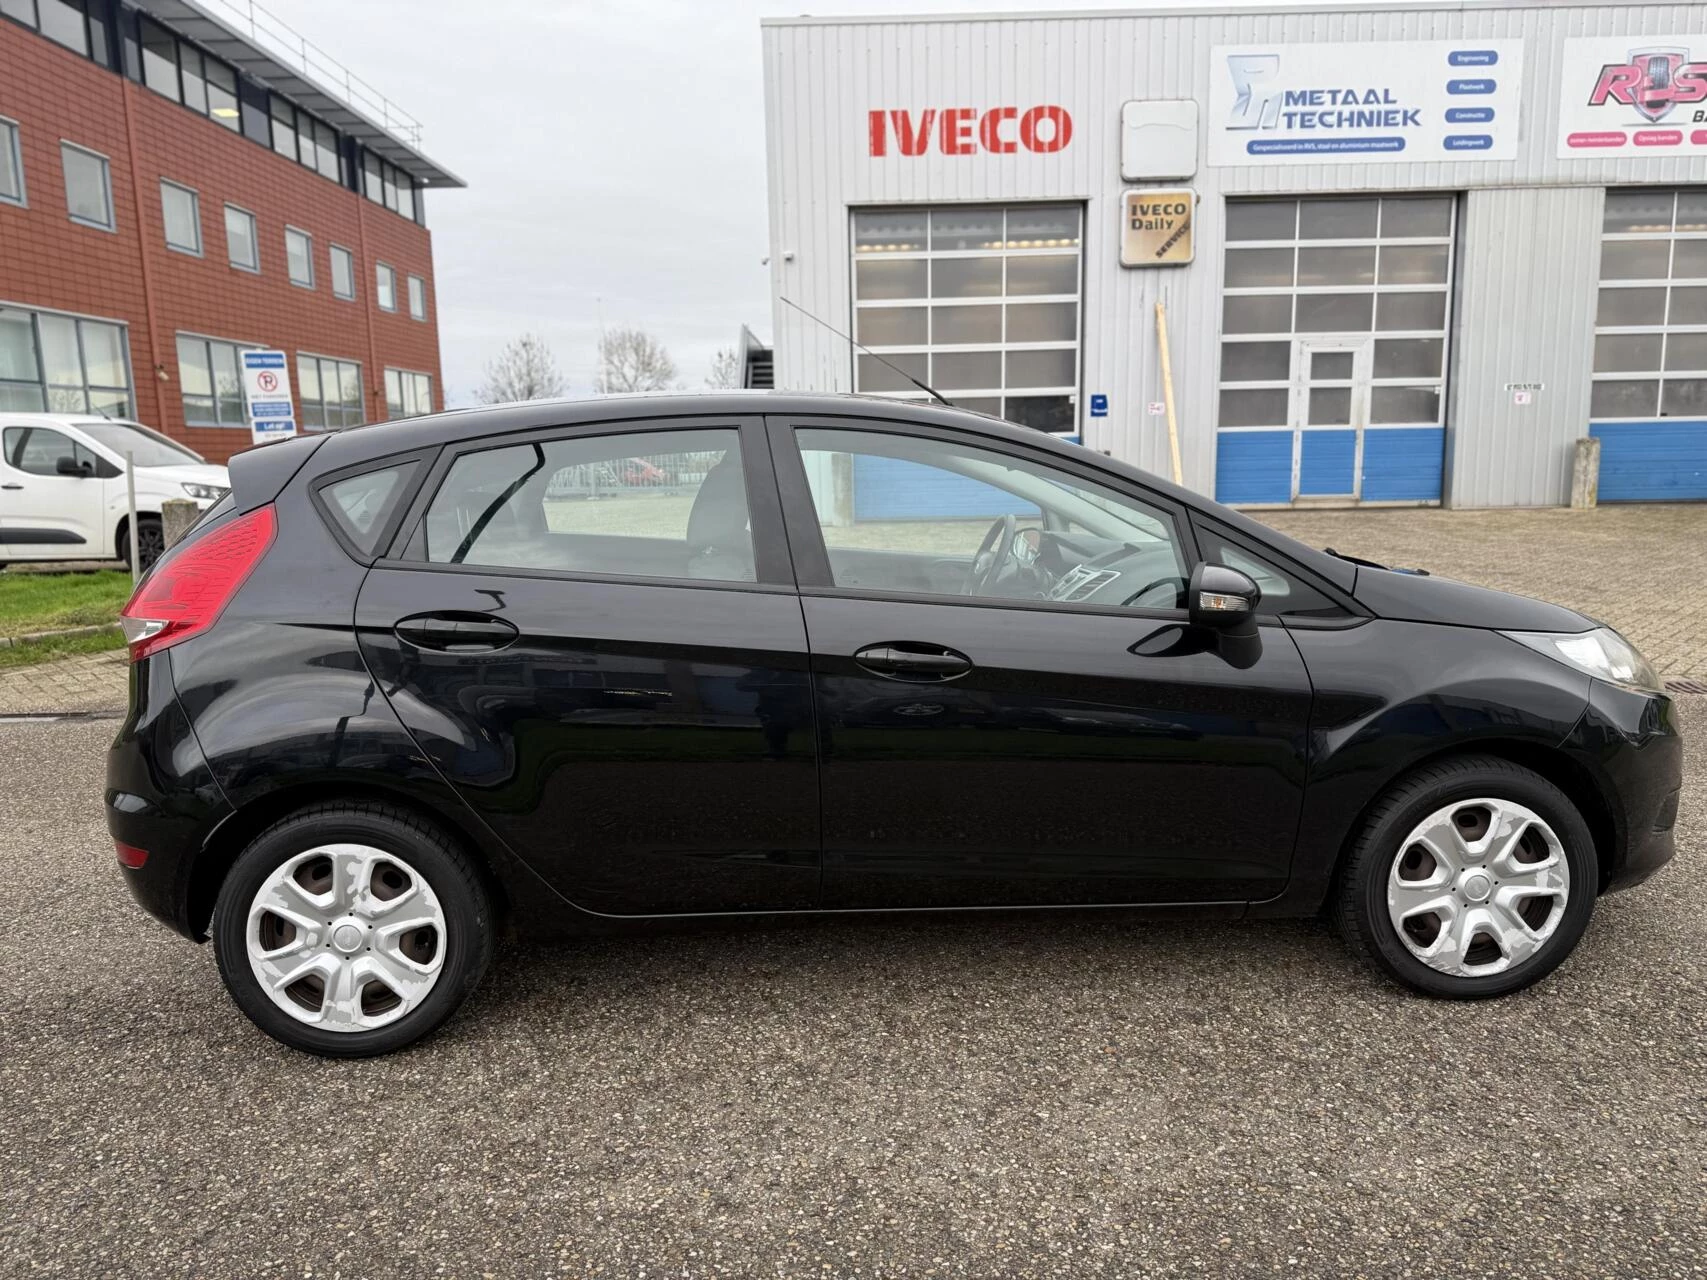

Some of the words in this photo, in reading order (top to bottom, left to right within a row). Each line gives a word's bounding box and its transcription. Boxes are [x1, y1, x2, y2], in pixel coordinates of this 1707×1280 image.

[1587, 62, 1707, 106] RS
[1285, 88, 1397, 107] METAAL
[1282, 108, 1422, 129] TECHNIEK
[868, 105, 1073, 157] IVECO
[1131, 203, 1186, 216] IVECO
[1131, 218, 1174, 230] Daily
[1155, 221, 1191, 258] SERVICE
